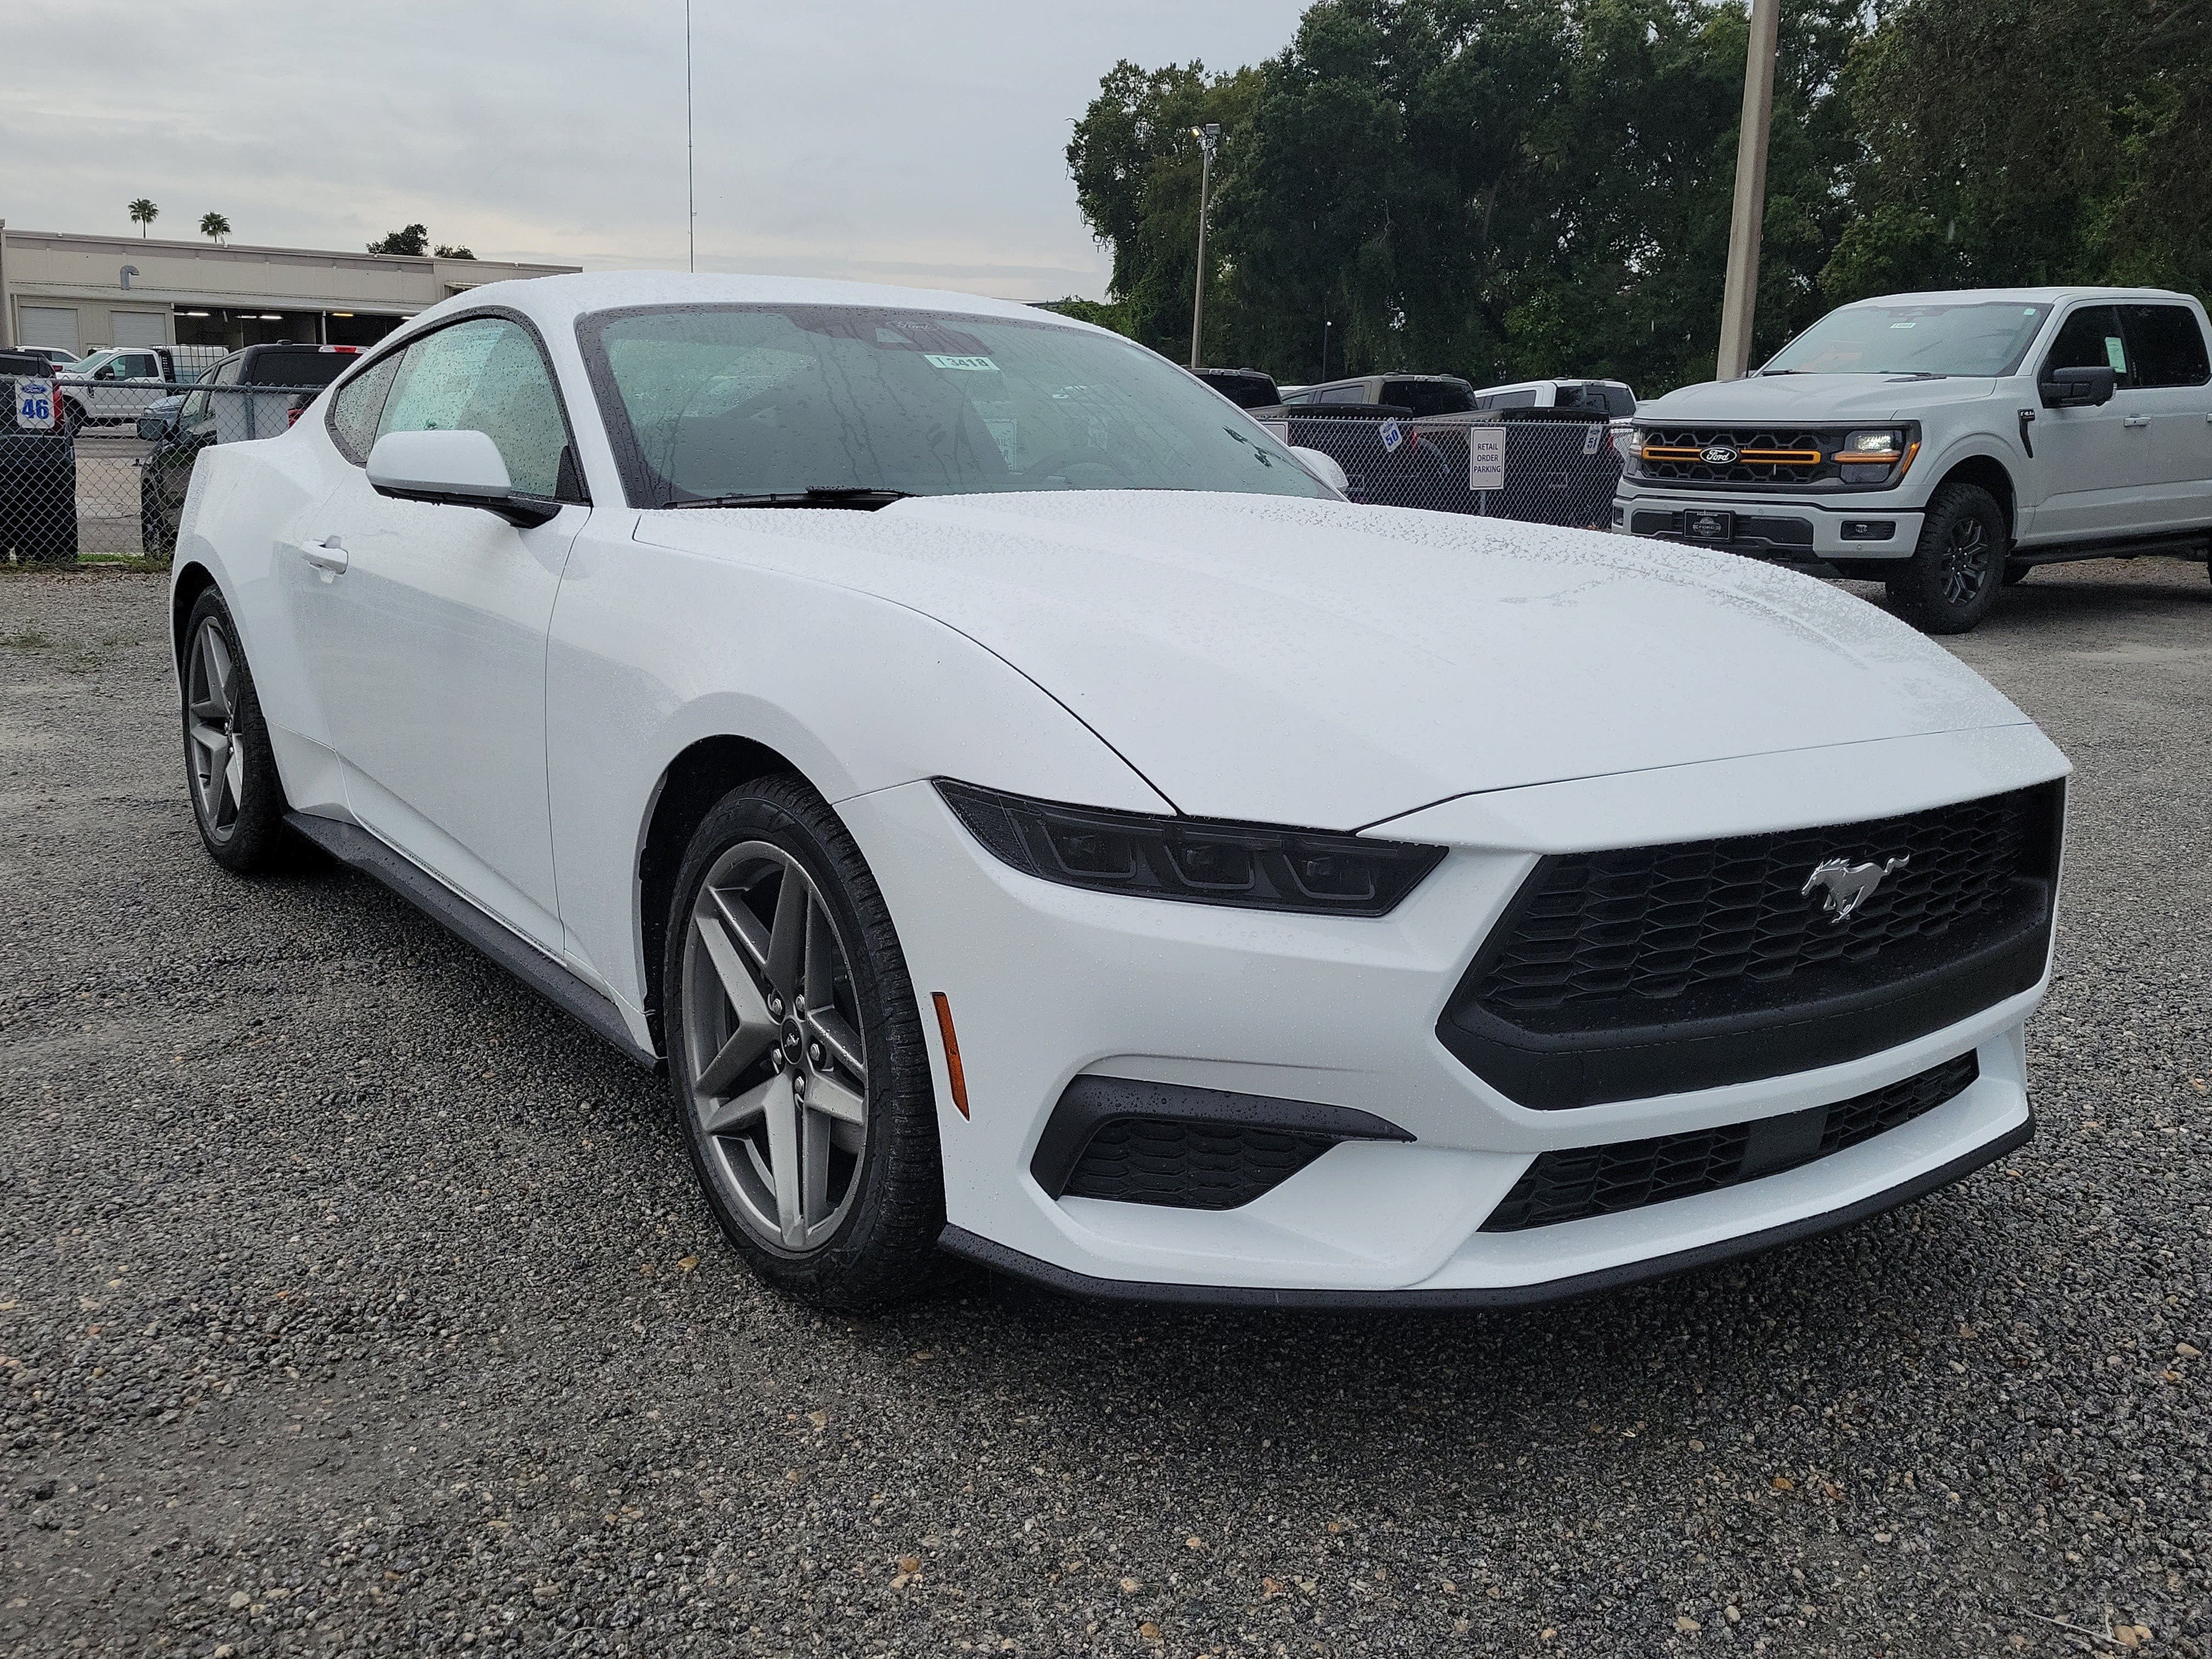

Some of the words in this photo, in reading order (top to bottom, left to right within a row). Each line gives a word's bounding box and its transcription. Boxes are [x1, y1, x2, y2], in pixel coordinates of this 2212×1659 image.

[22, 399, 49, 419] 46
[1385, 430, 1398, 446] 50
[1706, 449, 1730, 461] Ford
